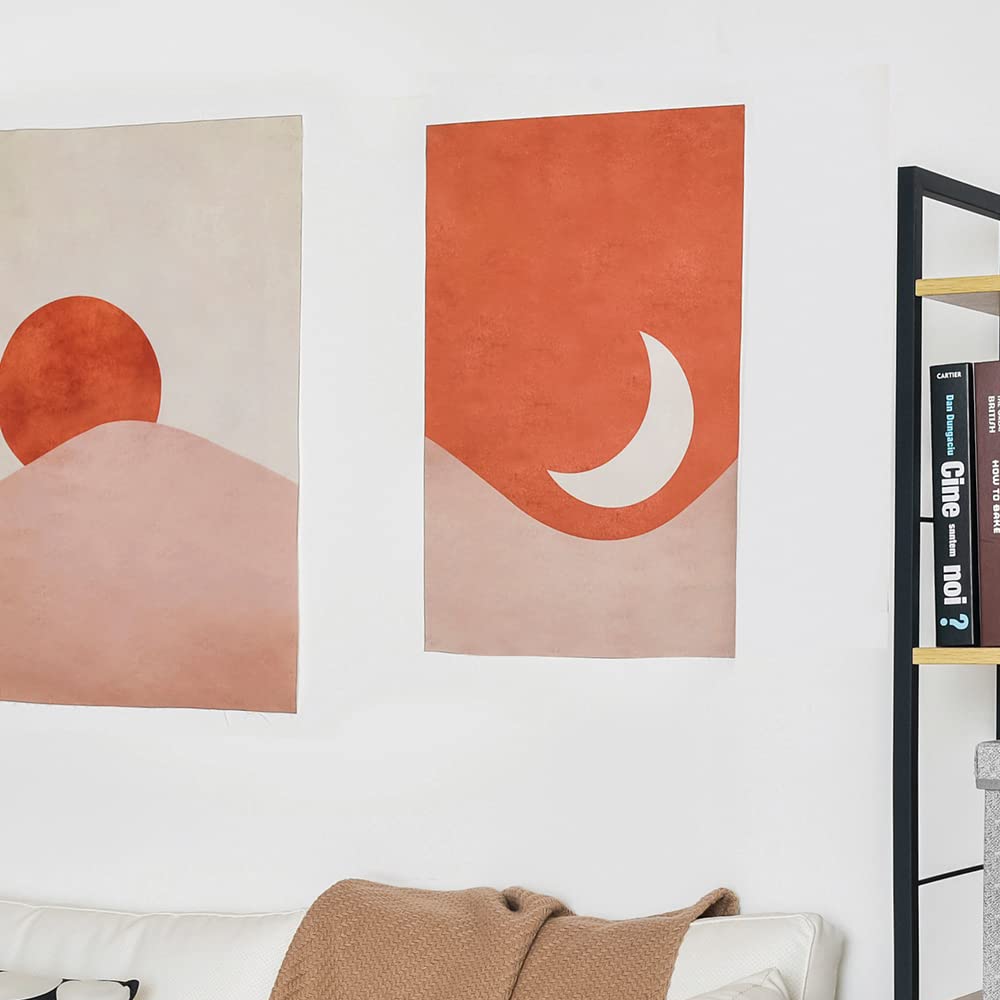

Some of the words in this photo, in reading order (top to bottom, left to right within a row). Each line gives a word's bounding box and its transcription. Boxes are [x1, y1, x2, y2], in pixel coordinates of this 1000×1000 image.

[937, 371, 962, 379] CARTIER
[946, 395, 954, 414] Dan
[988, 395, 996, 434] BRITISH
[946, 415, 954, 456] Dungaciu
[992, 459, 1000, 485] HOW
[940, 460, 965, 518] Cine
[992, 488, 1000, 501] TO
[943, 564, 967, 606] noi
